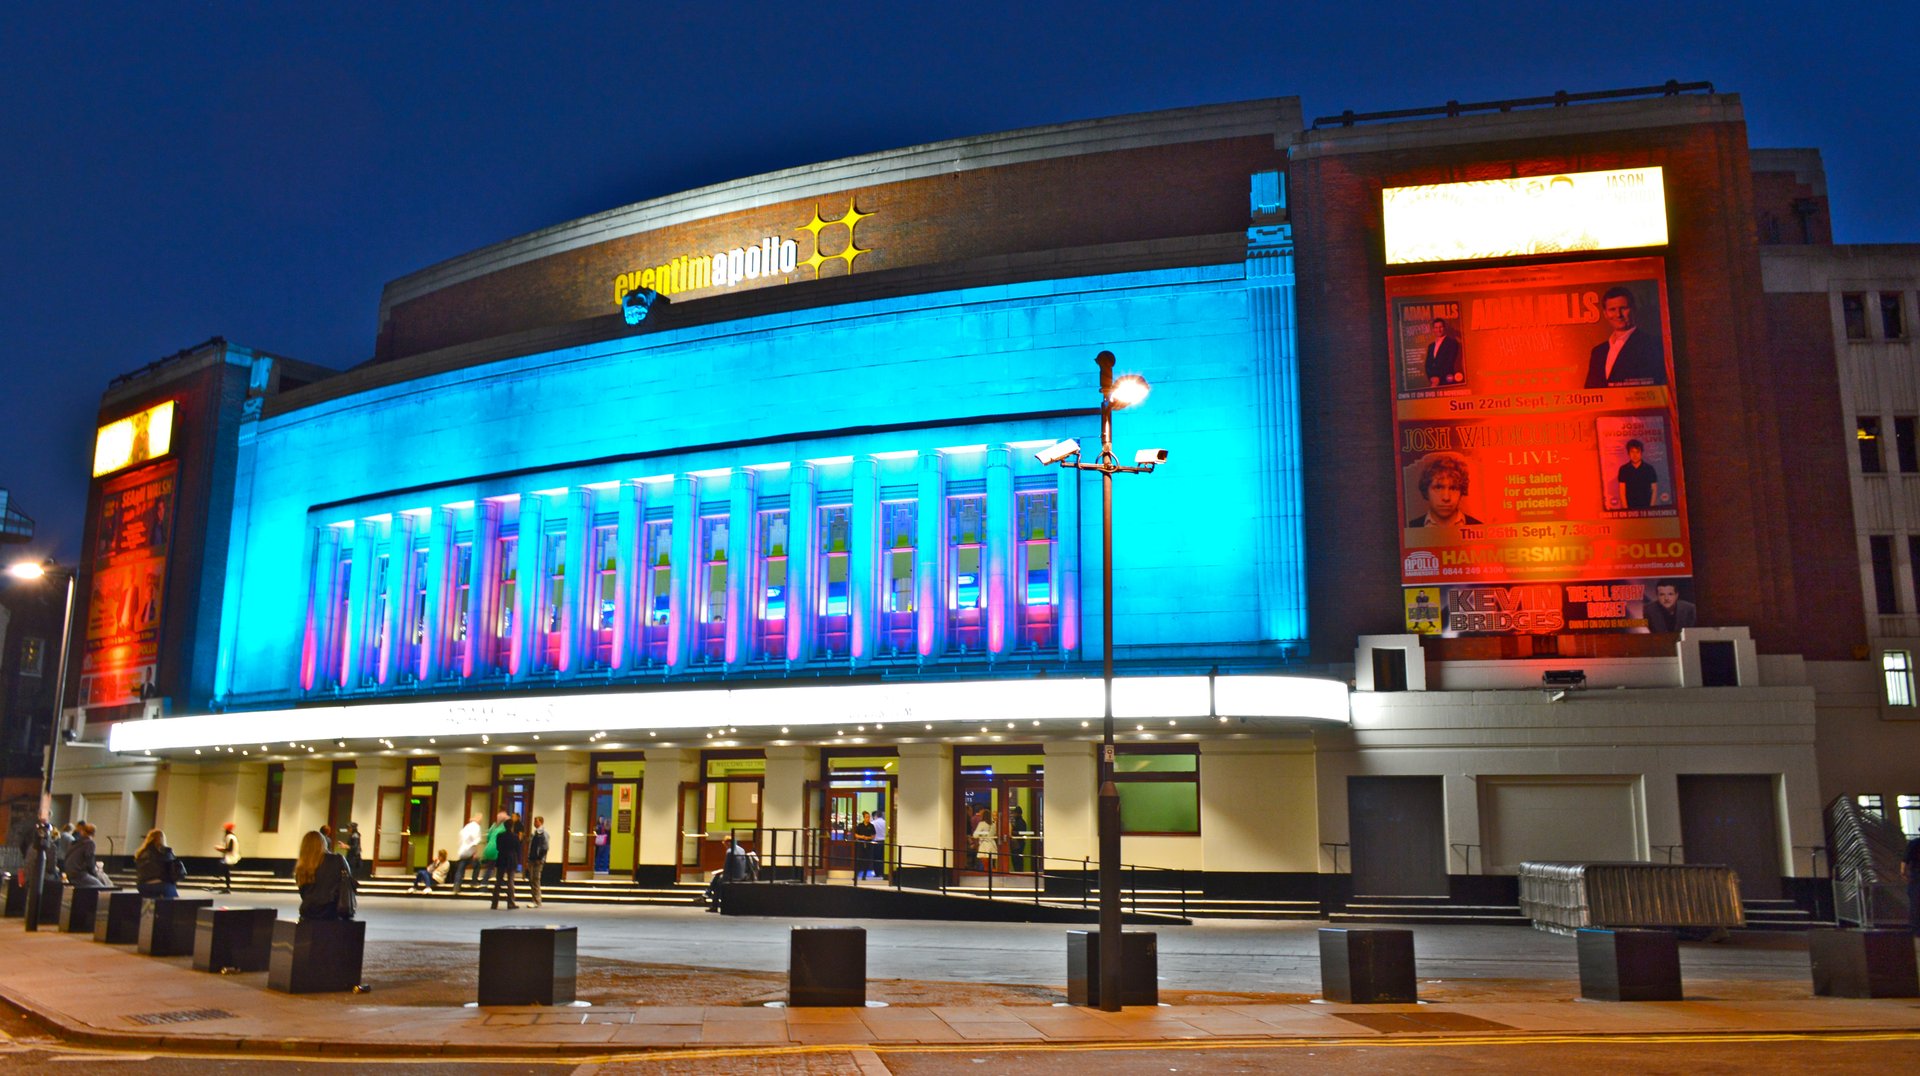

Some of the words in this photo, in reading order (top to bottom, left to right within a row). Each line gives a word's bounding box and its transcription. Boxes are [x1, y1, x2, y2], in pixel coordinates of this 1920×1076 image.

[1606, 172, 1645, 188] JASON
[1433, 303, 1459, 319] HILLS
[1471, 296, 1533, 330] ADAM
[1536, 291, 1600, 326] HILLS
[1450, 399, 1474, 411] Sun
[1479, 397, 1511, 409] 22nd
[1553, 392, 1604, 407] 7.30pm
[1621, 422, 1644, 430] JOSH
[1402, 427, 1451, 452] JOSH
[1529, 472, 1563, 484] talent
[1504, 487, 1520, 497] for
[1523, 485, 1569, 497] comedy
[1503, 500, 1512, 509] is
[1459, 528, 1484, 540] Thu
[1522, 525, 1556, 539] Sept,
[1441, 545, 1594, 565] HAMMERSMITH
[1602, 542, 1684, 560] APOLLO
[1405, 558, 1439, 570] APOLLO
[1442, 567, 1463, 575] 0844
[1450, 585, 1562, 612] KEVIN
[1611, 584, 1645, 601] STORY
[1450, 610, 1564, 632] BRIDGES
